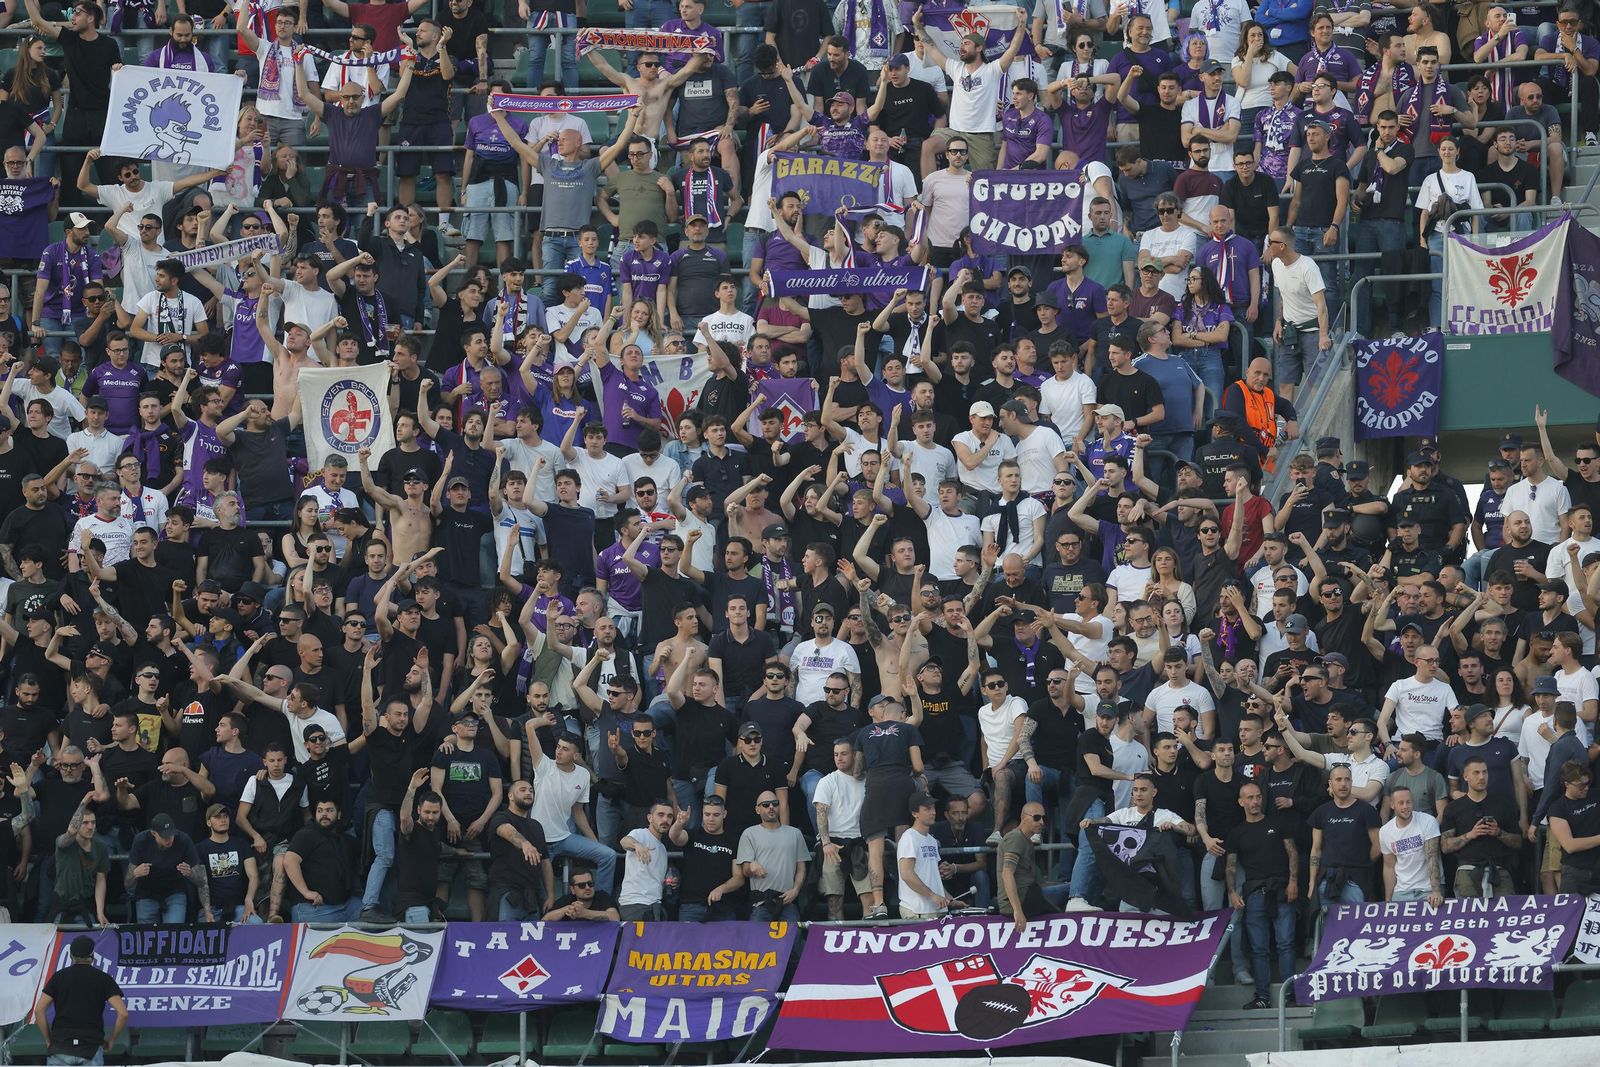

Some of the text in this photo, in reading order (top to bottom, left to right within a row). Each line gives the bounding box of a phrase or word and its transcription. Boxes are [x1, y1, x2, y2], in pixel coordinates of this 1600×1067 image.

[603, 33, 692, 48] FIORENTINA
[121, 87, 149, 133] SIAMO
[149, 75, 205, 96] FATTI
[498, 97, 631, 110] Compagnie Sbagliate
[973, 178, 1081, 201] Gruppo
[970, 211, 1081, 252] CHIOPPA
[786, 268, 909, 289] avanti ultras
[711, 322, 745, 331] adidas
[679, 356, 694, 381] B
[322, 379, 345, 416] SEVEN
[1357, 390, 1439, 431] Chioppa
[1337, 896, 1510, 921] FIORENTINA
[823, 916, 1218, 954] UNONOVEDUESEI
[1359, 913, 1546, 936] August 26th 1926
[121, 929, 226, 956] DIFFIDATI
[454, 921, 601, 958] TANTA
[56, 939, 284, 988] QELLI DI SEMPRE
[182, 956, 226, 964] SEMPRE
[627, 950, 778, 972] MARASMA
[649, 972, 752, 987] ULTRAS
[1308, 971, 1383, 1001] Pride
[1424, 965, 1545, 990] Florence
[111, 996, 233, 1011] RENZE
[598, 993, 771, 1040] MAIO
